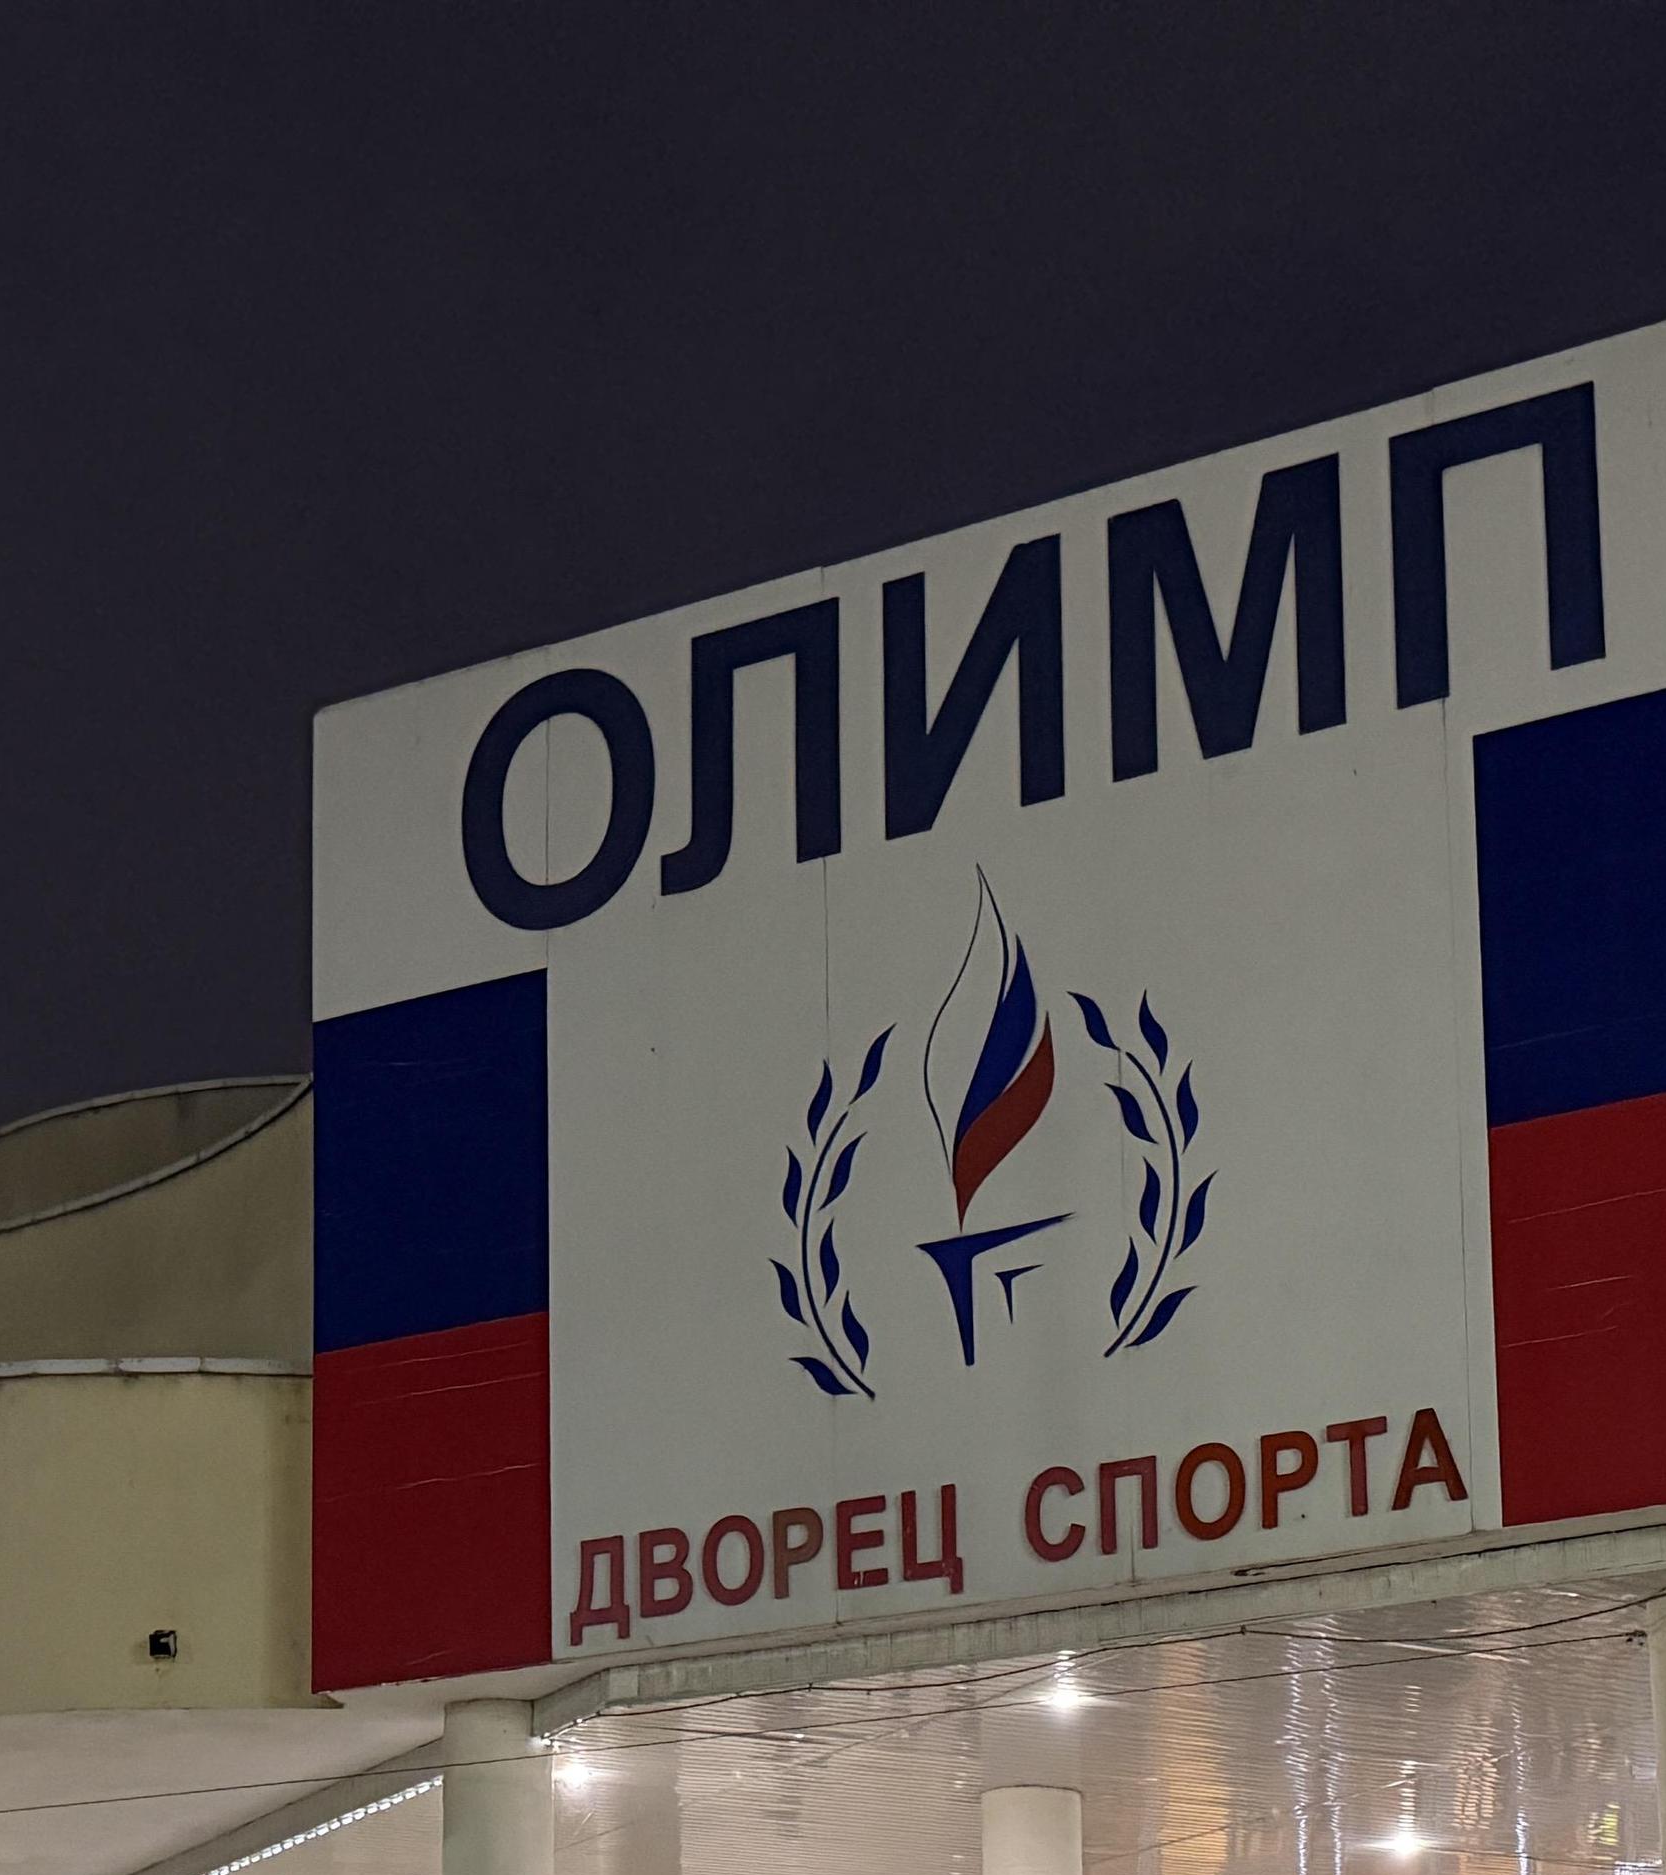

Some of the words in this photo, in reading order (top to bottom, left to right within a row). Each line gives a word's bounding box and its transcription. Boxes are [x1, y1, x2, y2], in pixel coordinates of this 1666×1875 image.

[461, 381, 1607, 931] ОЛИМП
[569, 1483, 964, 1647] ДВОРЕЦ
[1024, 1407, 1469, 1563] СПОРТА
